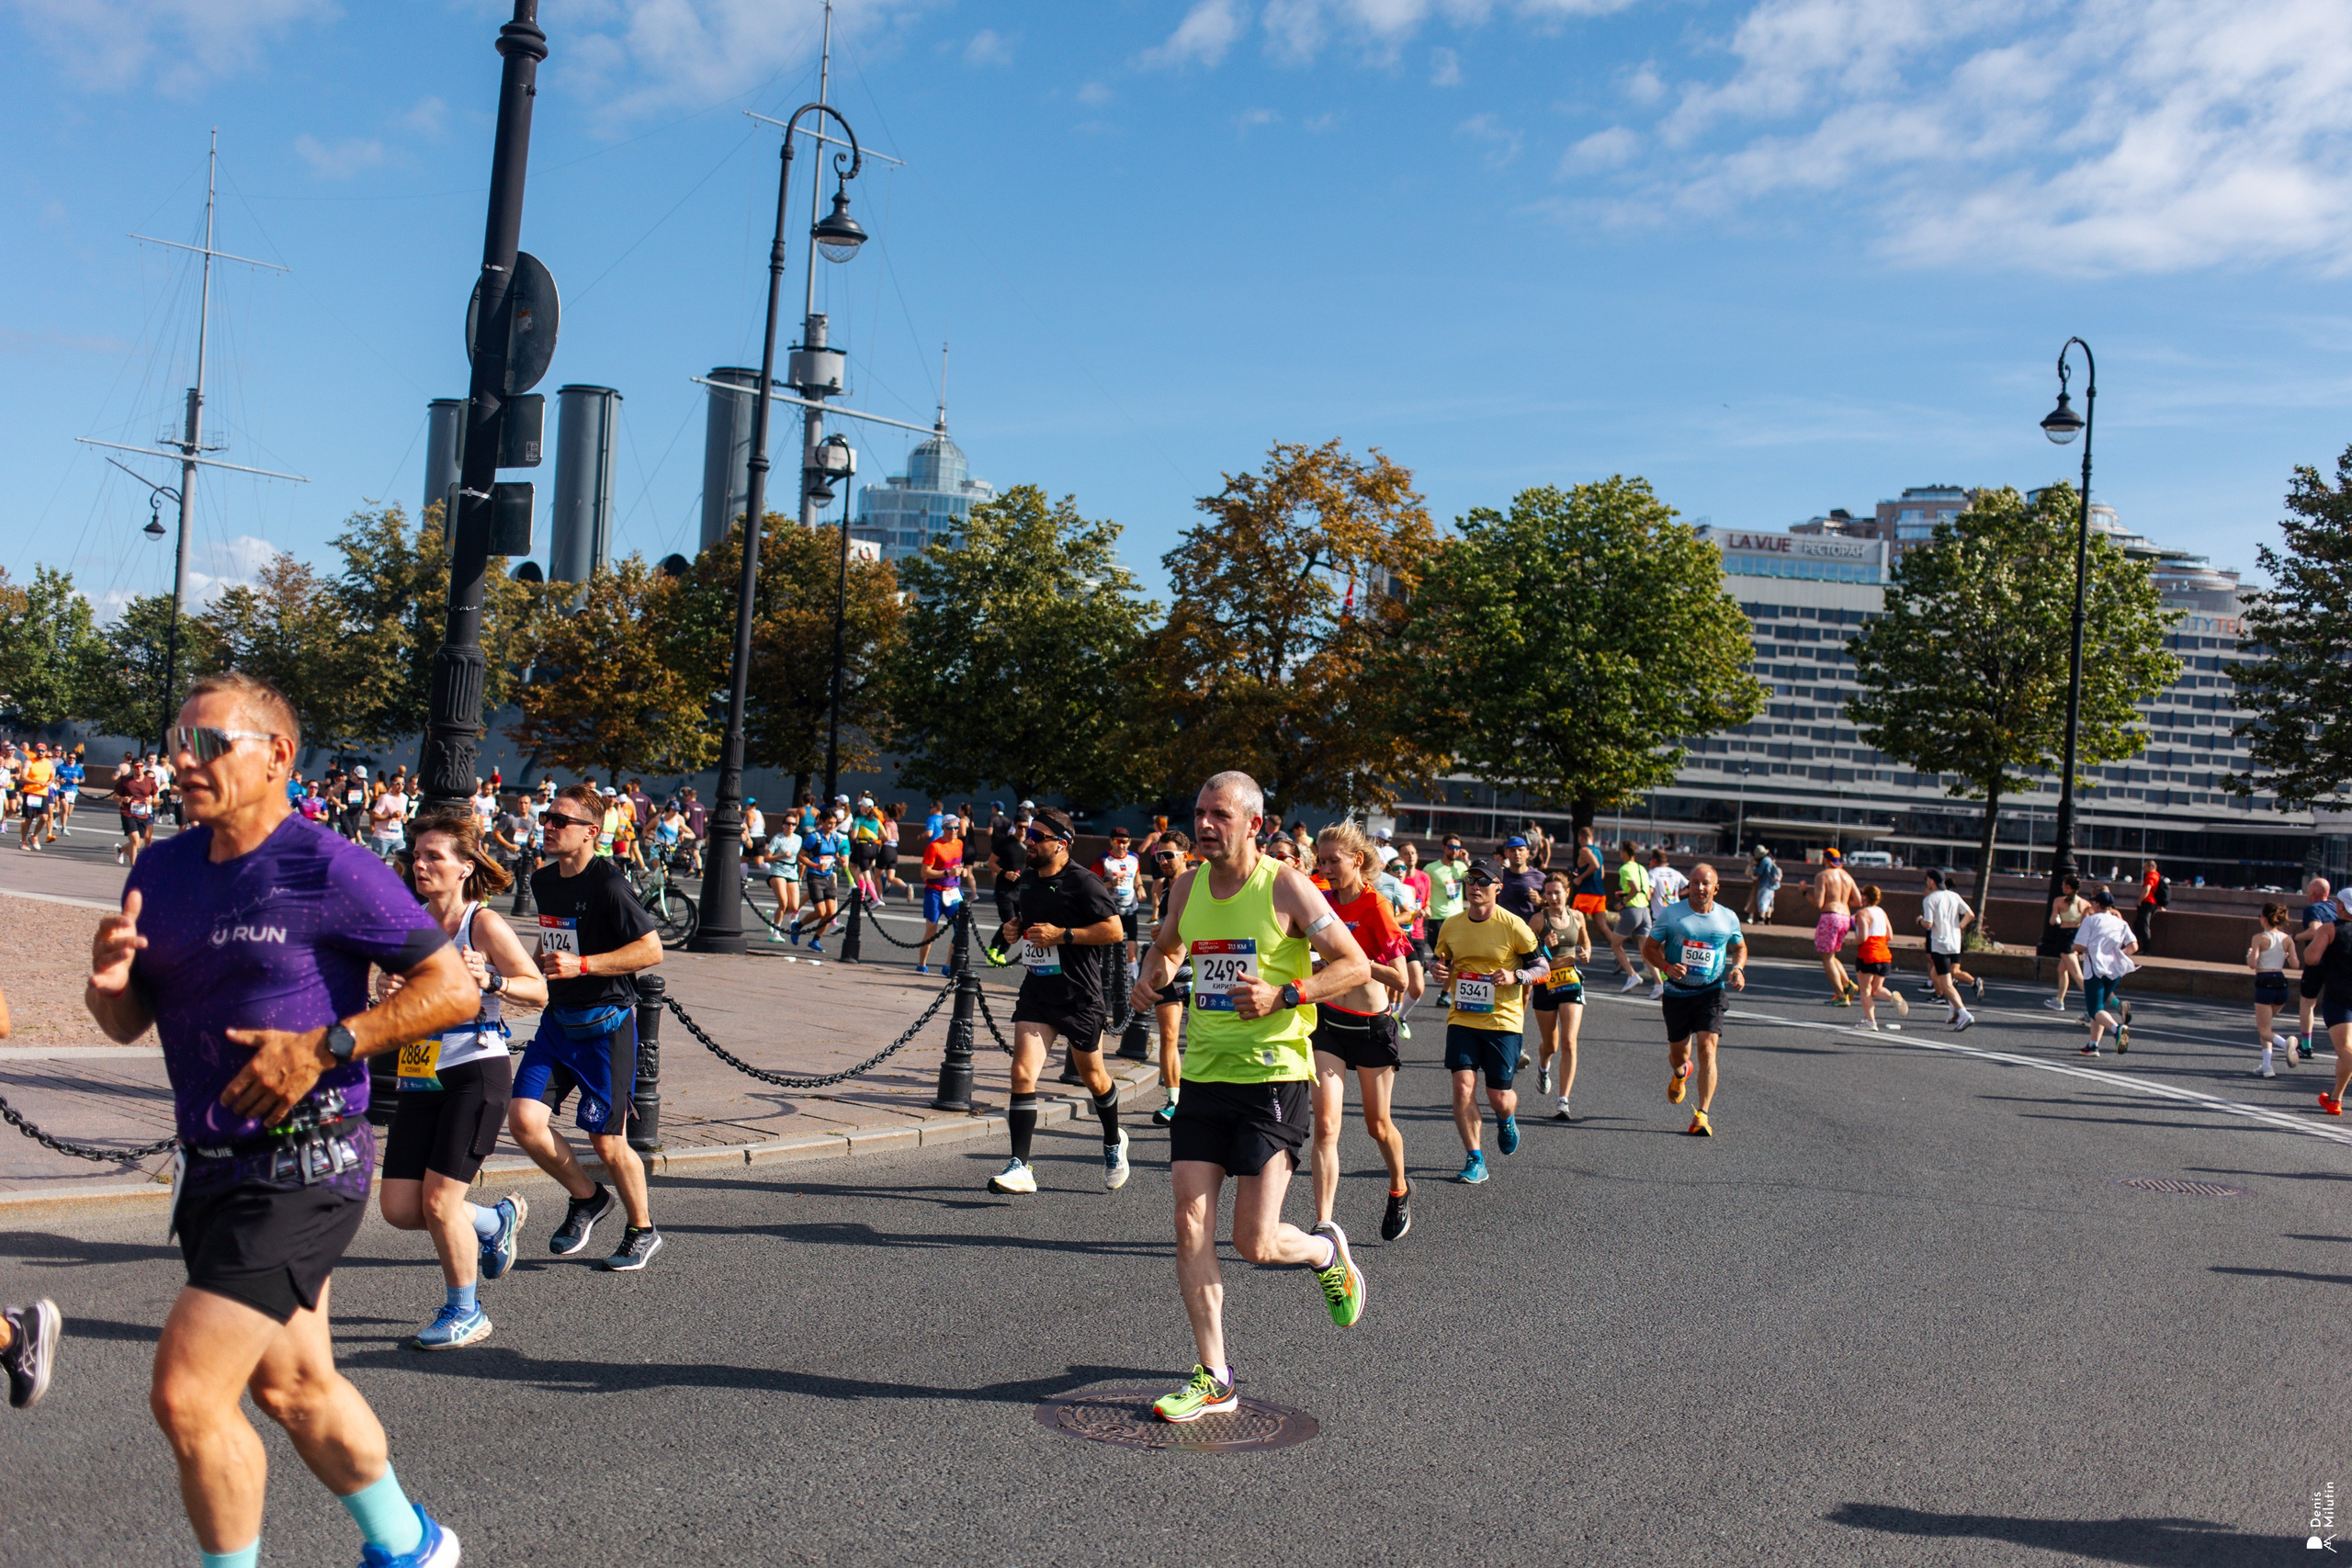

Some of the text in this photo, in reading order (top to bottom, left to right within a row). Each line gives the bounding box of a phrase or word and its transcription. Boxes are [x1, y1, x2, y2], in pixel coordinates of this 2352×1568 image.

[1728, 534, 1792, 551] LA VUE
[1804, 541, 1865, 558] РЕСТОРАН
[232, 925, 288, 943] RUN
[543, 931, 571, 952] 4124
[1025, 944, 1051, 957] 3201
[1686, 950, 1711, 962] 5048
[1204, 959, 1248, 982] 2492
[1460, 983, 1487, 998] 5341
[1199, 995, 1207, 1008] D
[401, 1043, 431, 1066] 2884
